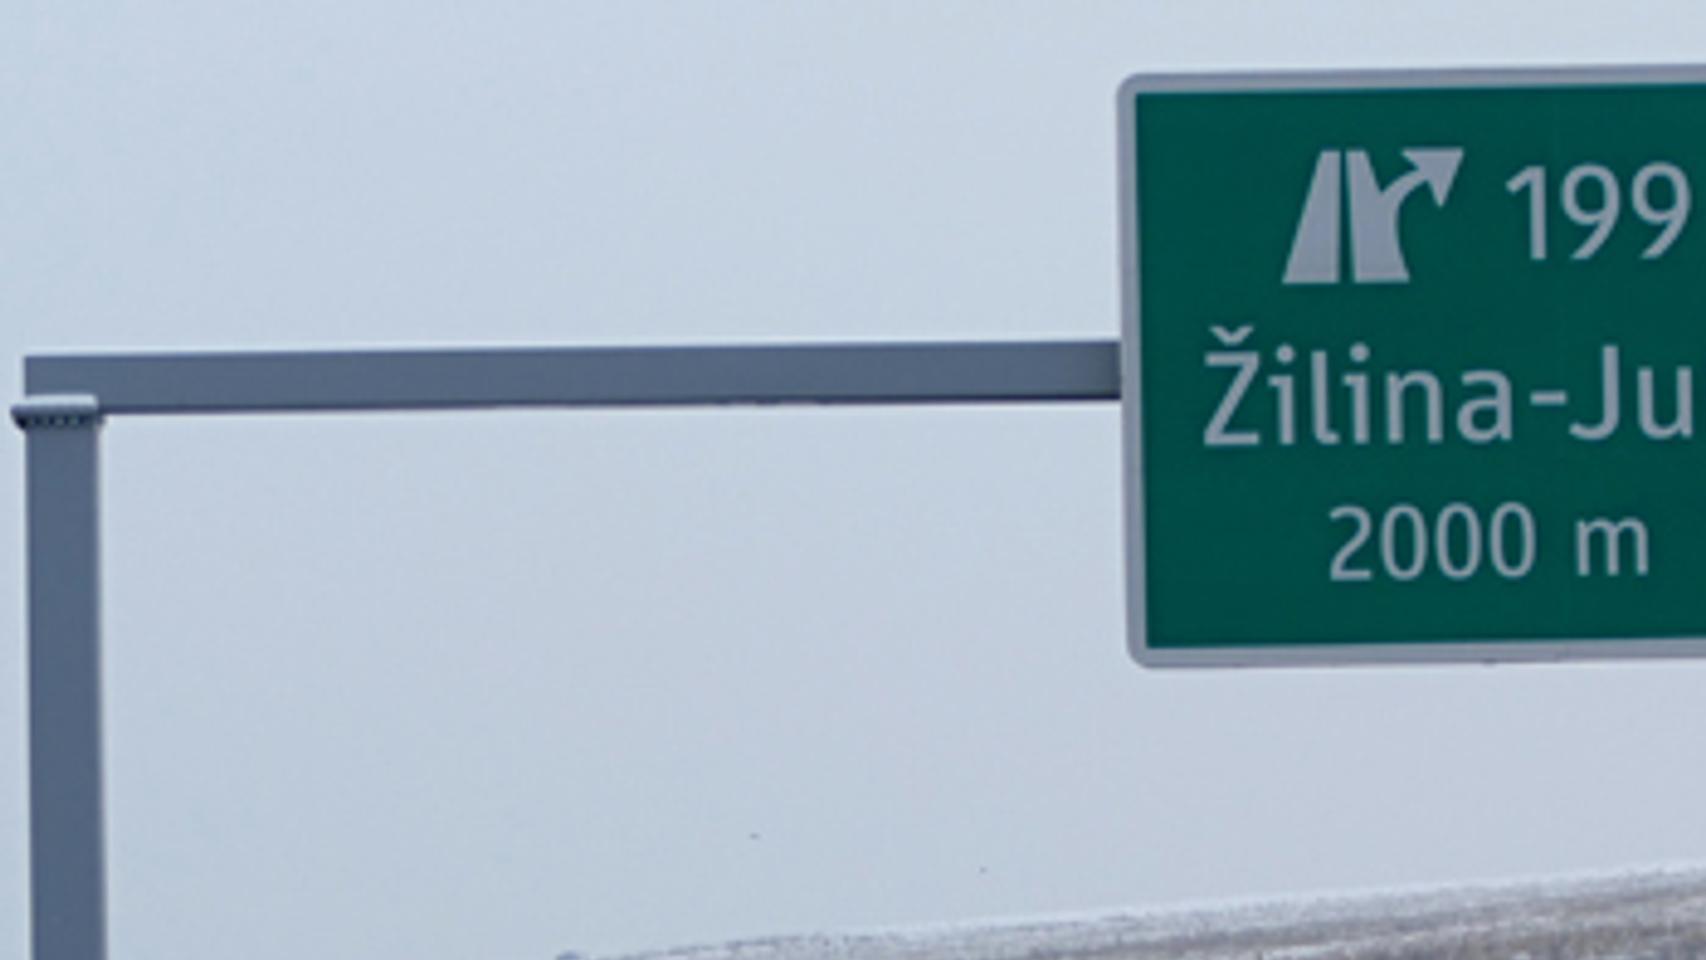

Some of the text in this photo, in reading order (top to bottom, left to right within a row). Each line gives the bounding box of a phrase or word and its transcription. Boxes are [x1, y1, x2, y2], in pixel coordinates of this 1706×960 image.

[1505, 161, 1693, 260] 199
[1328, 502, 1651, 582] 2000 m
